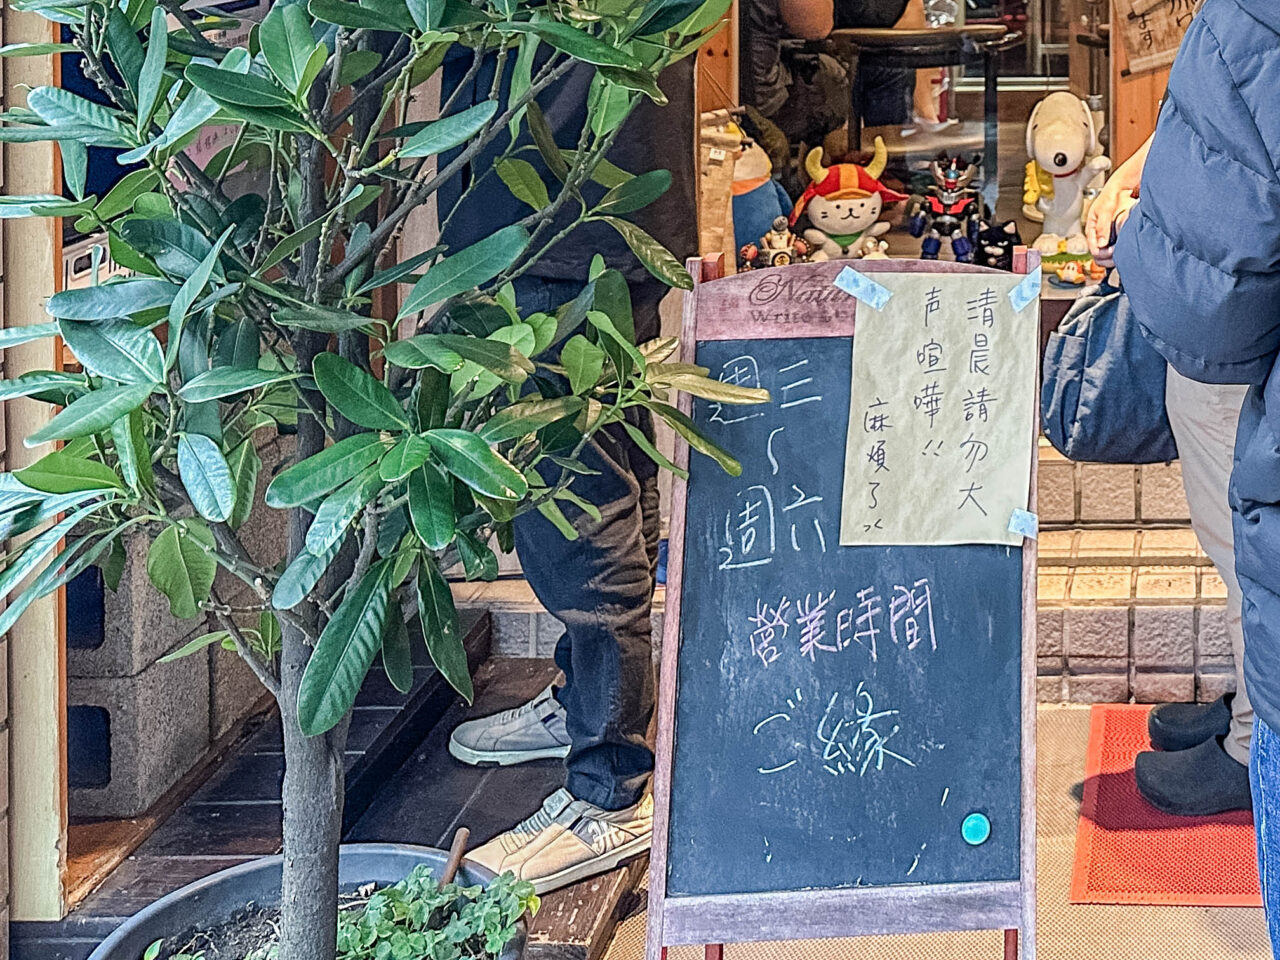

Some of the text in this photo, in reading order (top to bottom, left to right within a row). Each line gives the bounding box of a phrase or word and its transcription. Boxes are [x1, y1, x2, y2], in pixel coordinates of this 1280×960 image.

[958, 287, 998, 517] 清晨請勿大
